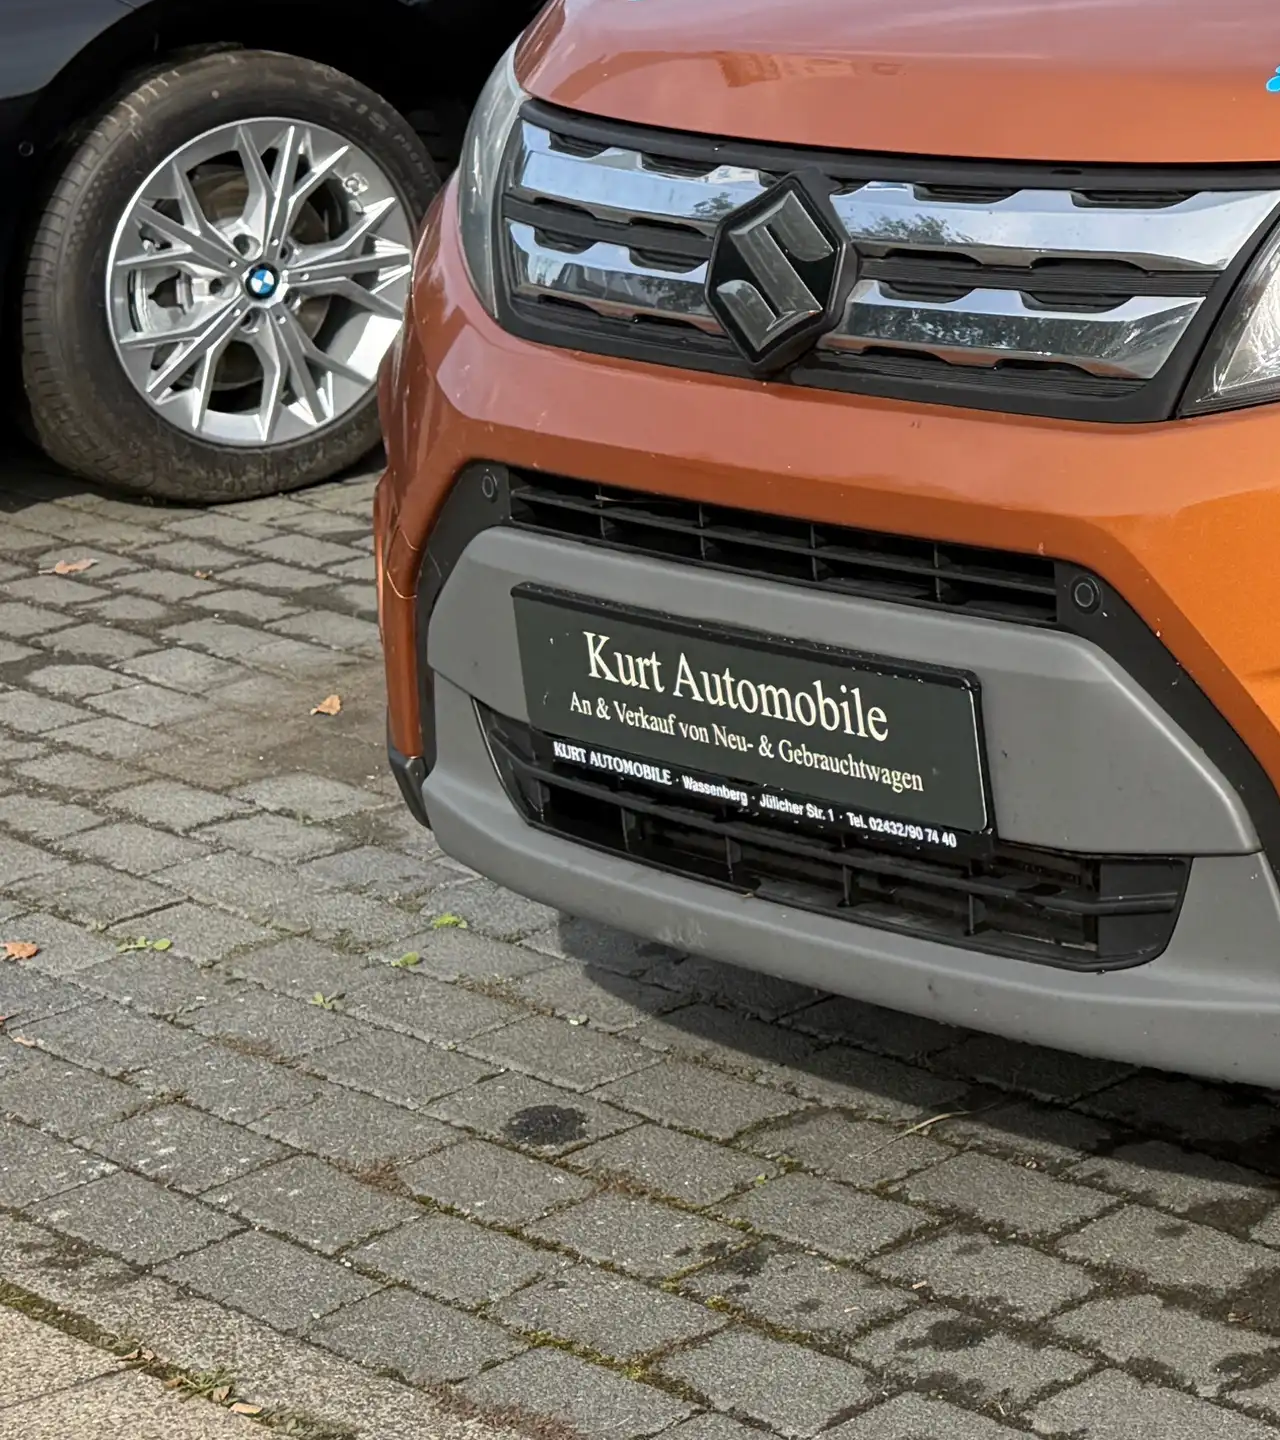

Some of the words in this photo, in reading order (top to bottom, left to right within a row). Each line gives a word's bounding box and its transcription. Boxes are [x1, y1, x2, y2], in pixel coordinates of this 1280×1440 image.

[583, 631, 664, 693] Kurt
[673, 652, 889, 742] Automobile
[552, 740, 587, 764] KURT
[589, 750, 673, 786] AUTOMOBILE
[682, 774, 749, 807] Wassenberg
[759, 792, 804, 816] Jülicher
[805, 803, 826, 821] Str.
[828, 808, 835, 822] 1
[846, 811, 868, 829] Tel.
[868, 815, 924, 841] 02432/90
[925, 828, 939, 844] 74
[941, 831, 958, 849] 40
[570, 691, 591, 715] An
[596, 698, 611, 720] &
[614, 701, 676, 736] Verkauf
[678, 721, 710, 744] von
[712, 723, 754, 753] Neu-
[758, 735, 775, 758] &
[778, 739, 925, 793] Gebrauchtwagen
